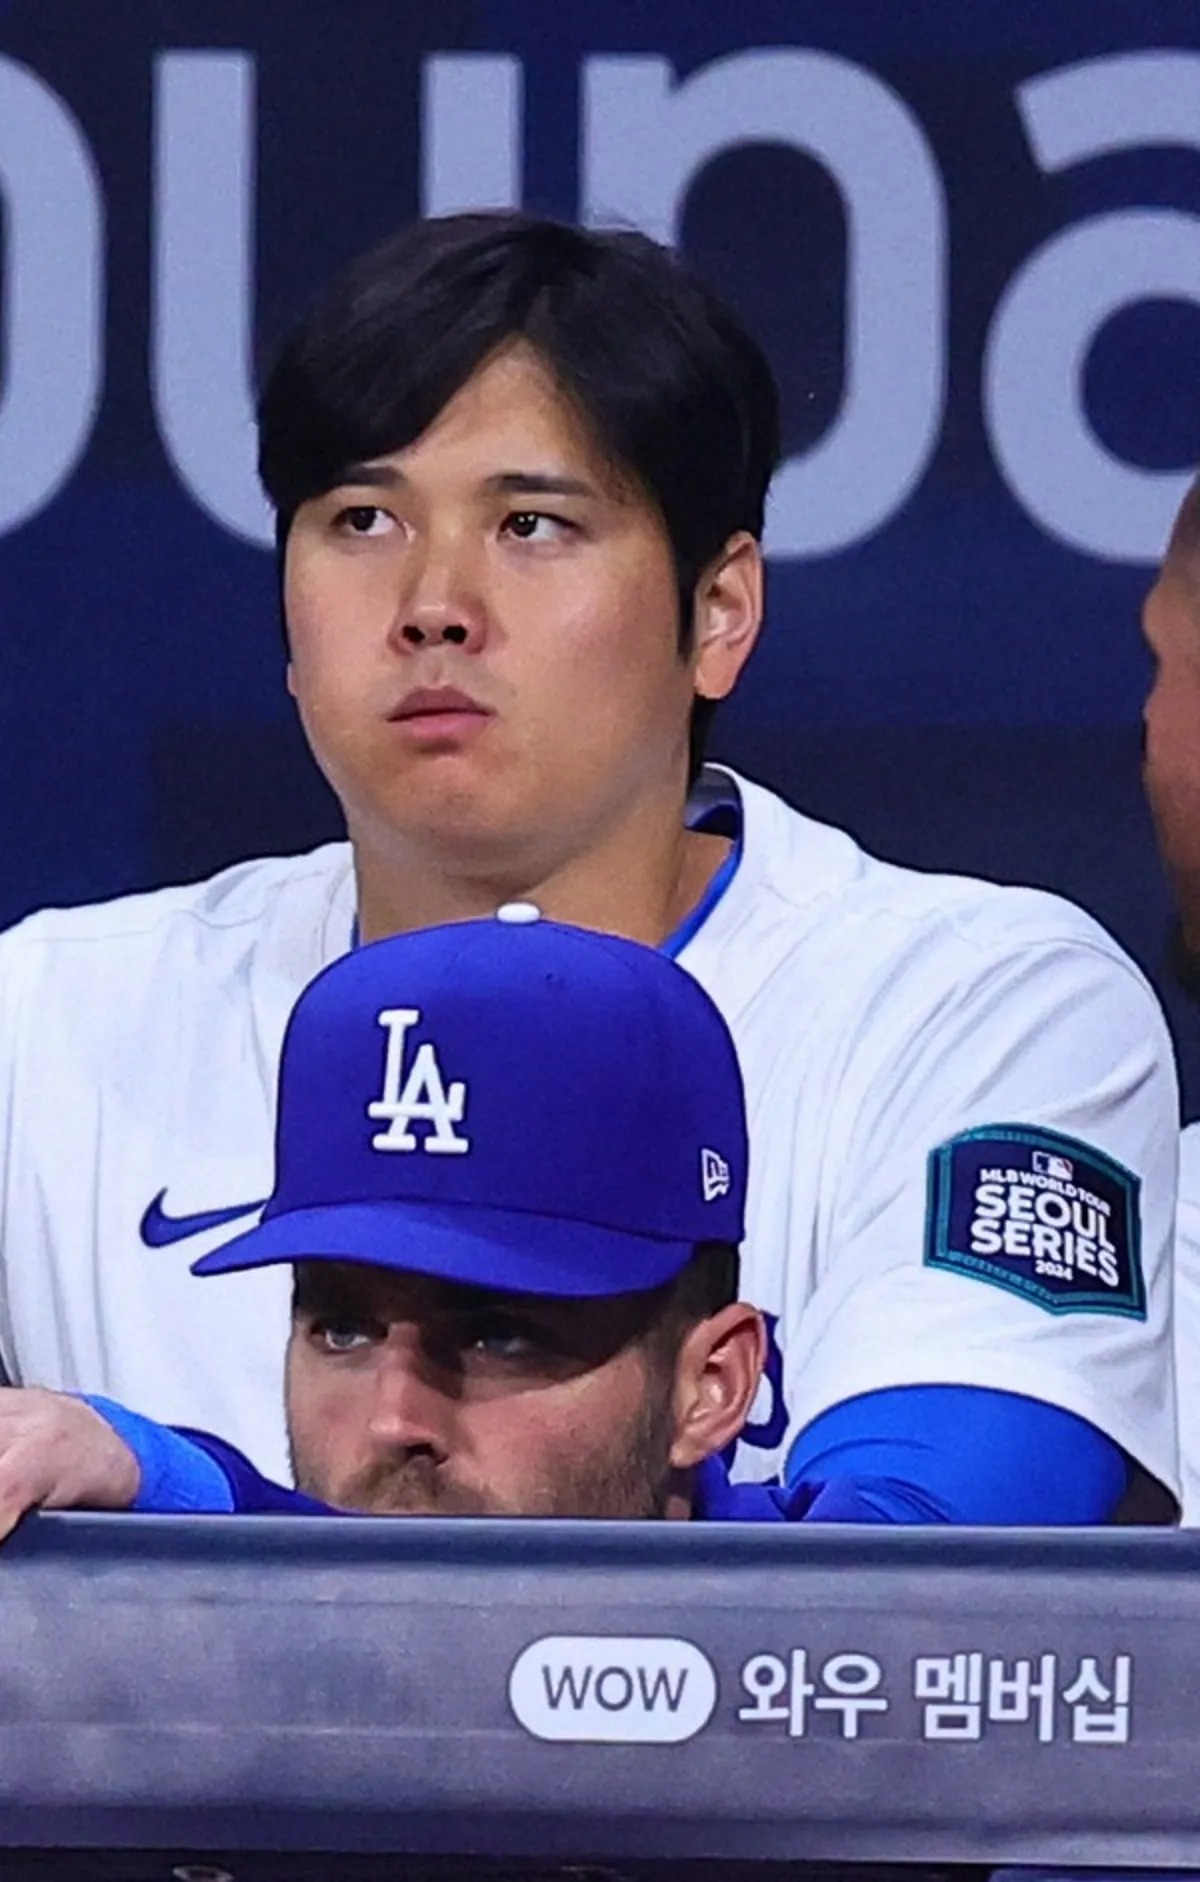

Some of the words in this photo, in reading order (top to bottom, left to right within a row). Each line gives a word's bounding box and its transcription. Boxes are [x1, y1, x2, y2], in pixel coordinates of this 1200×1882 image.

[368, 1009, 468, 1153] LA
[980, 1168, 1018, 1183] MLB
[1020, 1171, 1077, 1198] WORLD
[970, 1218, 1119, 1287] SERIES
[975, 1184, 1116, 1254] SEOUL
[1035, 1259, 1073, 1281] 2024
[541, 1665, 688, 1711] WOW
[738, 1649, 888, 1738] 와우
[914, 1653, 1131, 1743] 멤버십
